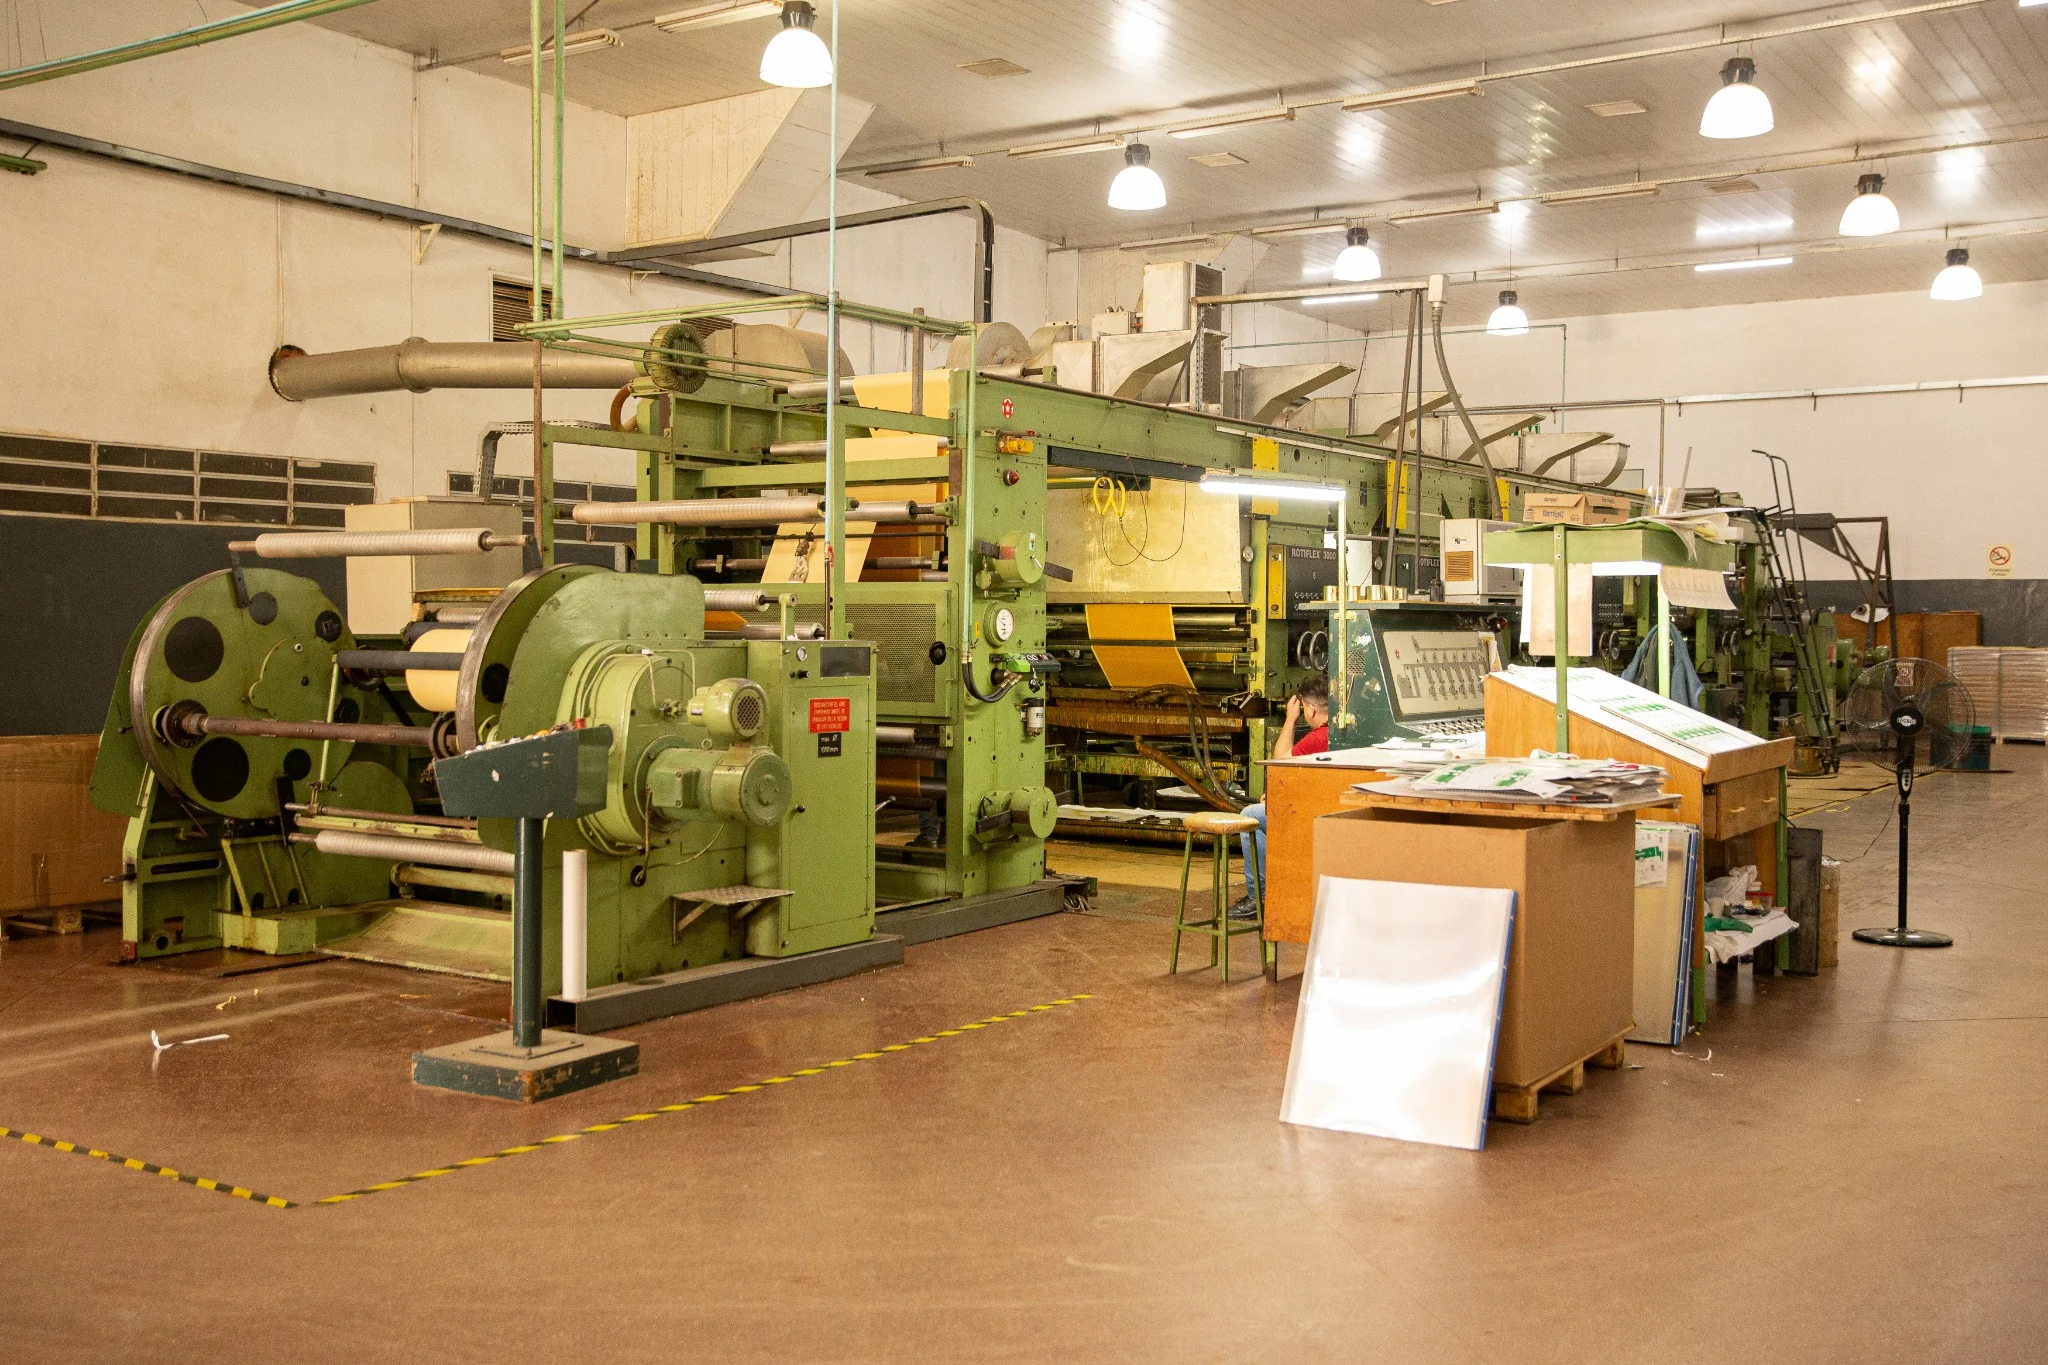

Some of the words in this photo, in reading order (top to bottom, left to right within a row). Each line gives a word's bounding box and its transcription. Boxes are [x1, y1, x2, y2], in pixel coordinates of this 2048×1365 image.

[1291, 547, 1321, 560] ROTIFLEX
[1322, 551, 1337, 560] 3000
[1312, 571, 1317, 580] 6
